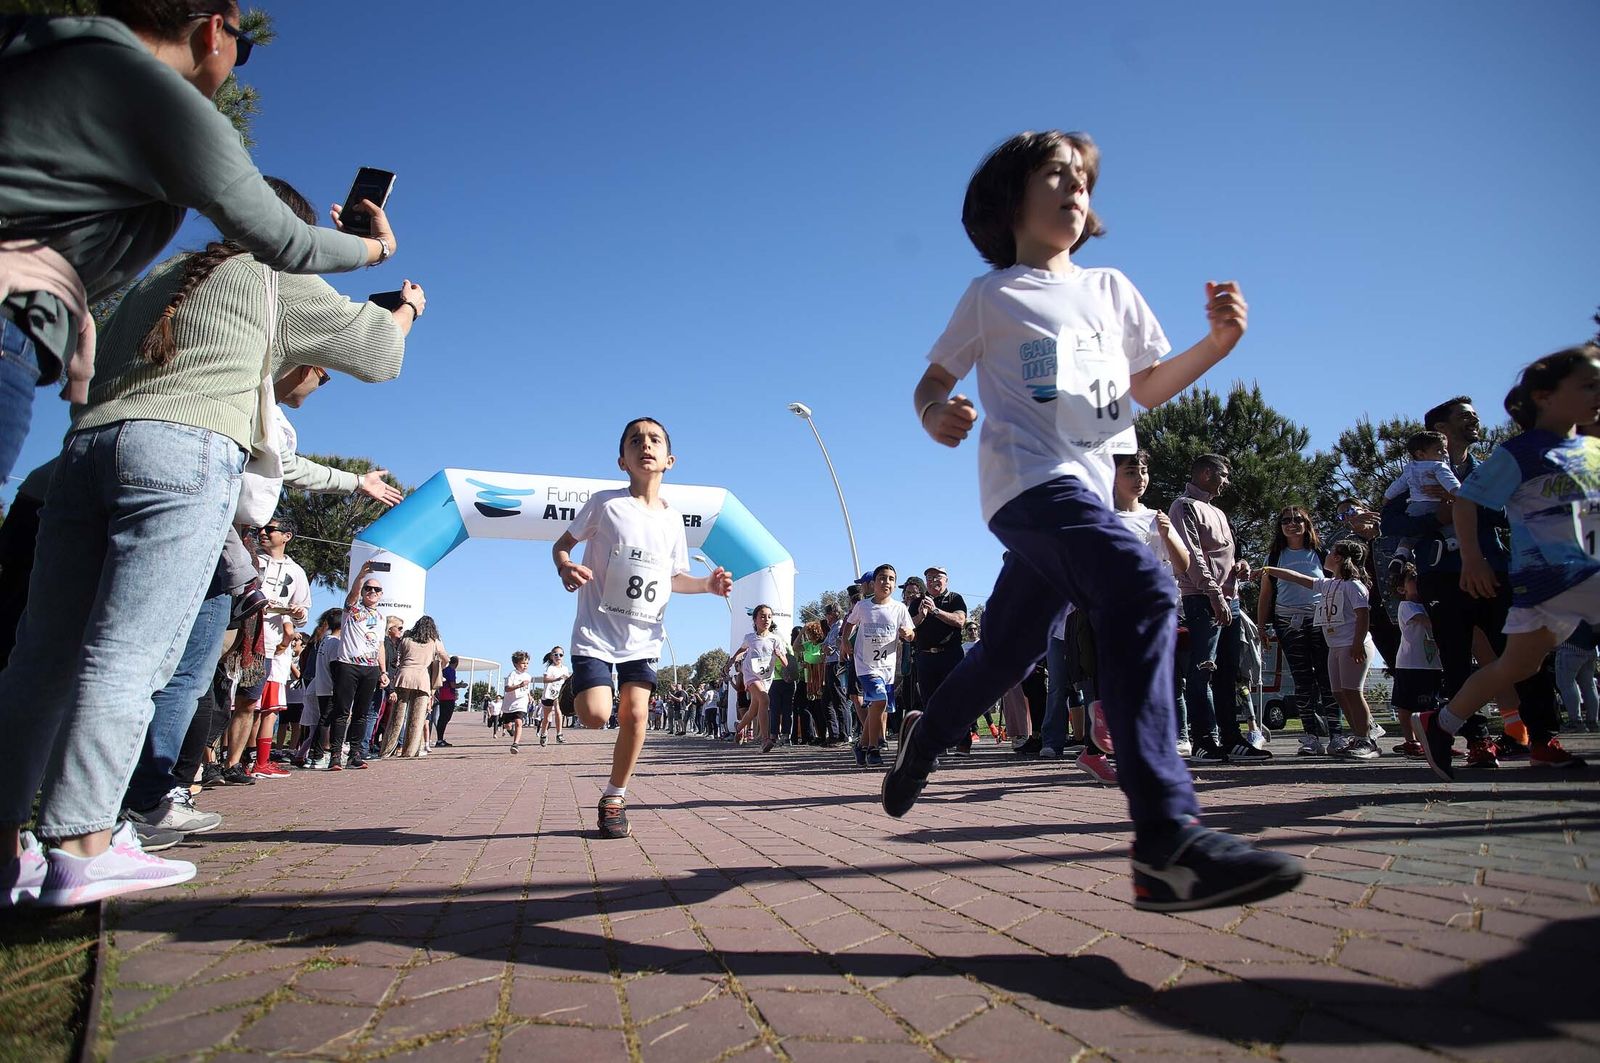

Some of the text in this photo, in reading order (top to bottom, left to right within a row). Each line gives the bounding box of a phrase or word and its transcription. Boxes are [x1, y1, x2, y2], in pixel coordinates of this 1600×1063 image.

[1089, 378, 1120, 421] 18
[547, 486, 590, 504] Fund
[682, 514, 702, 528] ER
[626, 575, 658, 603] 86
[872, 649, 888, 661] 24
